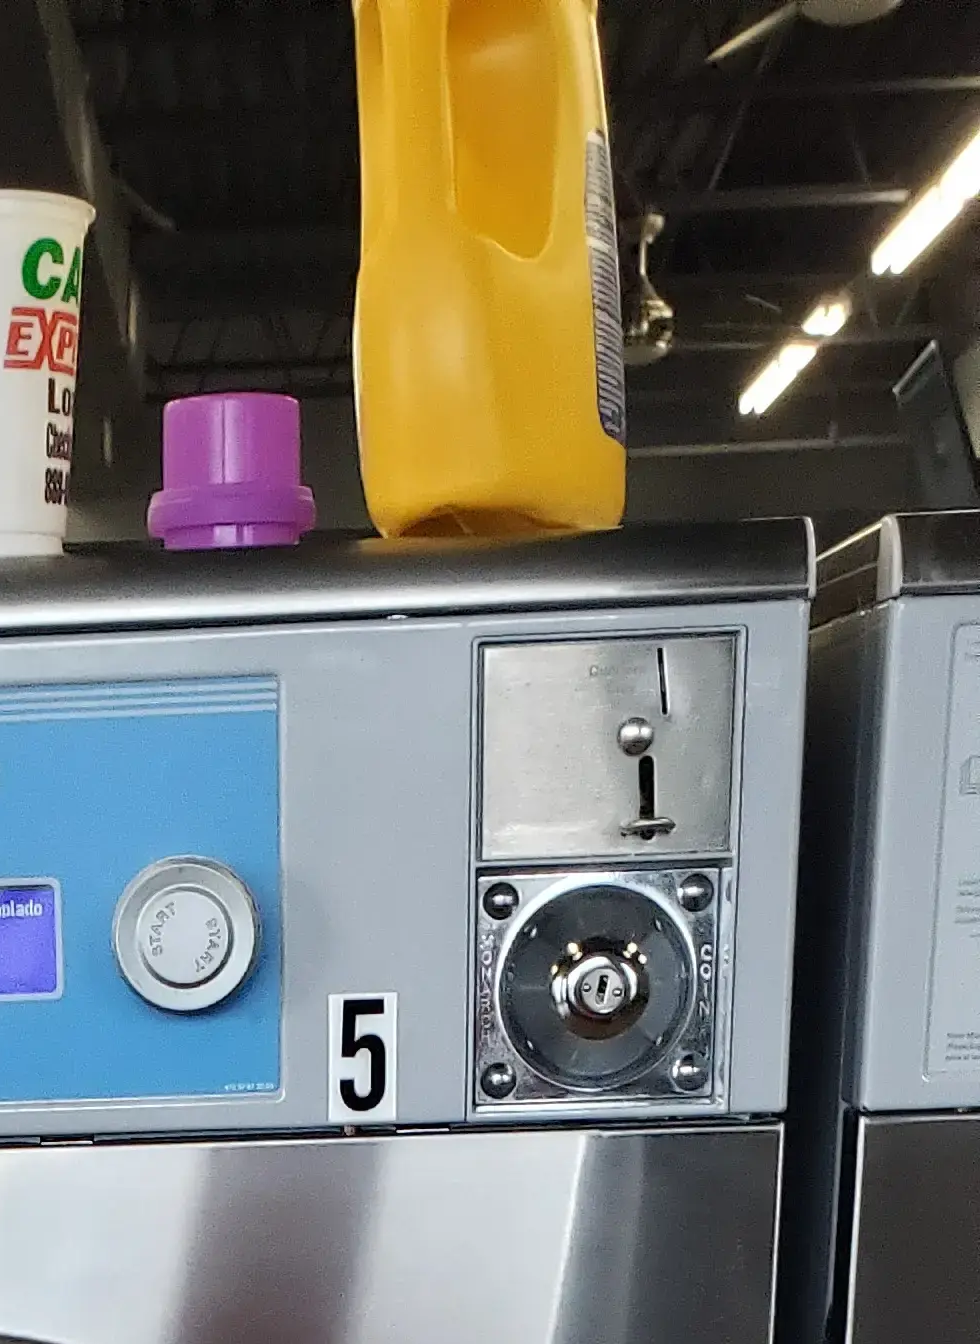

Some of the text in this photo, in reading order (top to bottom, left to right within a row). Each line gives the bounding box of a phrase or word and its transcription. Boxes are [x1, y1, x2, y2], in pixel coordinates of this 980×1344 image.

[4, 307, 77, 375] EXP
[149, 902, 176, 957] START
[700, 943, 713, 1017] COIN
[340, 999, 385, 1111] 5
